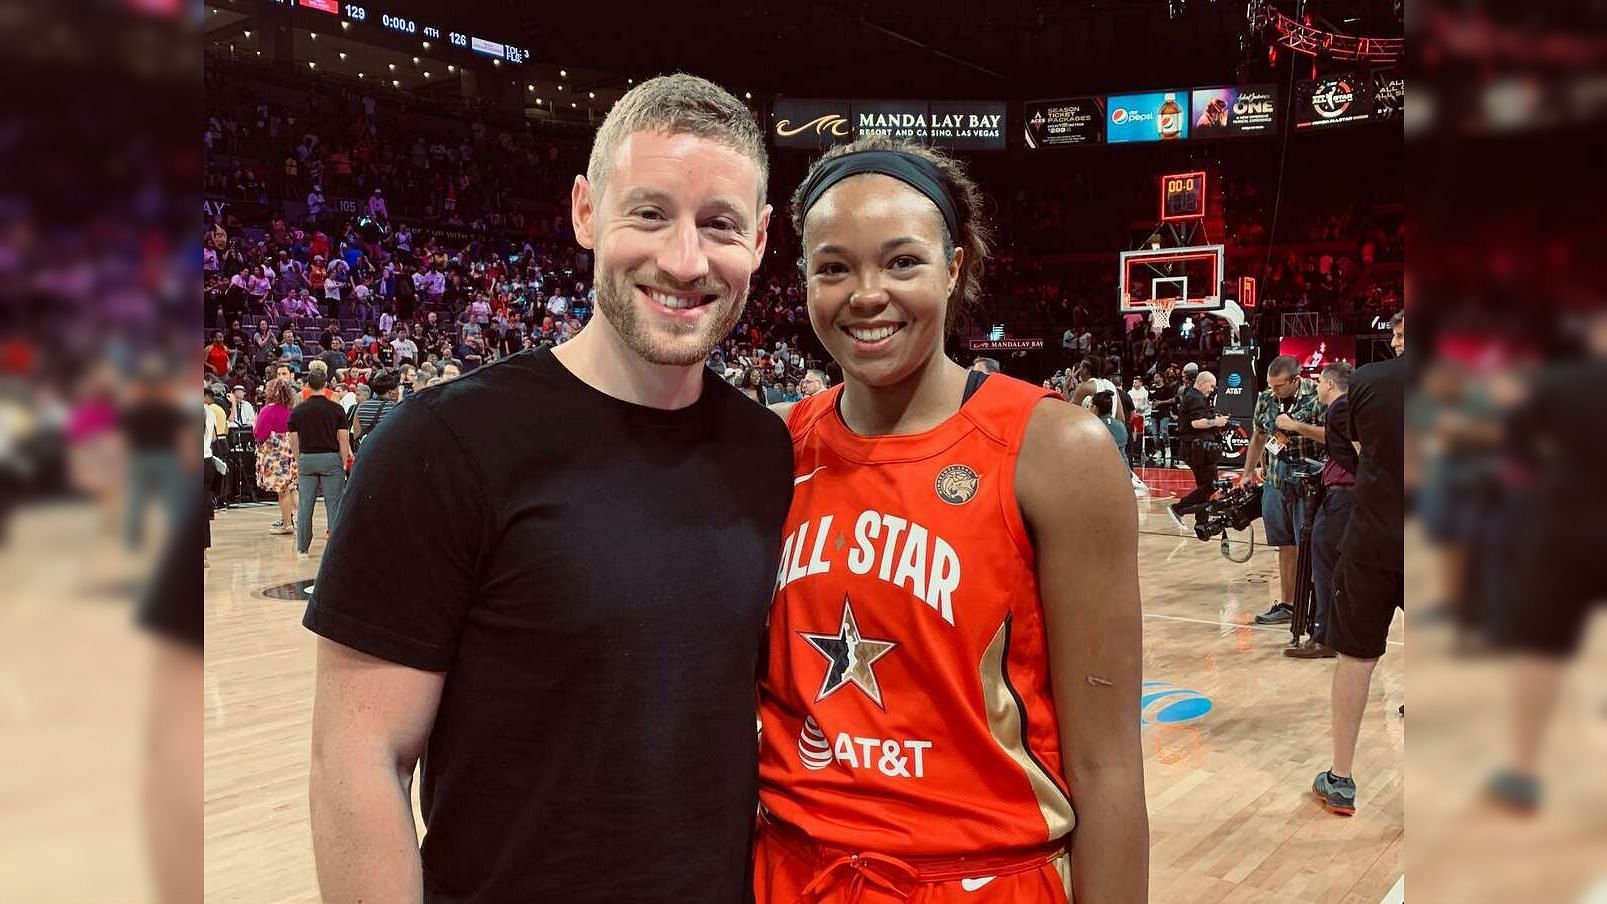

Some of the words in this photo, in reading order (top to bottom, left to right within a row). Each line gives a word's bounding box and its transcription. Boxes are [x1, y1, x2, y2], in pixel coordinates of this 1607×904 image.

[345, 4, 366, 20] 129
[382, 14, 415, 33] 0:00.0
[423, 26, 440, 39] 4TH
[449, 32, 467, 46] 126
[523, 49, 530, 58] 3
[1233, 102, 1274, 115] ONE
[968, 114, 1001, 129] BAY
[1047, 115, 1092, 123] PACKAGES
[1128, 112, 1153, 122] pepsi
[896, 129, 914, 137] AND
[973, 130, 999, 138] VEGAS
[339, 200, 356, 212] 105
[1225, 387, 1243, 395] AT&T
[776, 513, 834, 593] ALL
[847, 509, 961, 627] STAR
[834, 732, 932, 779] AT&T
